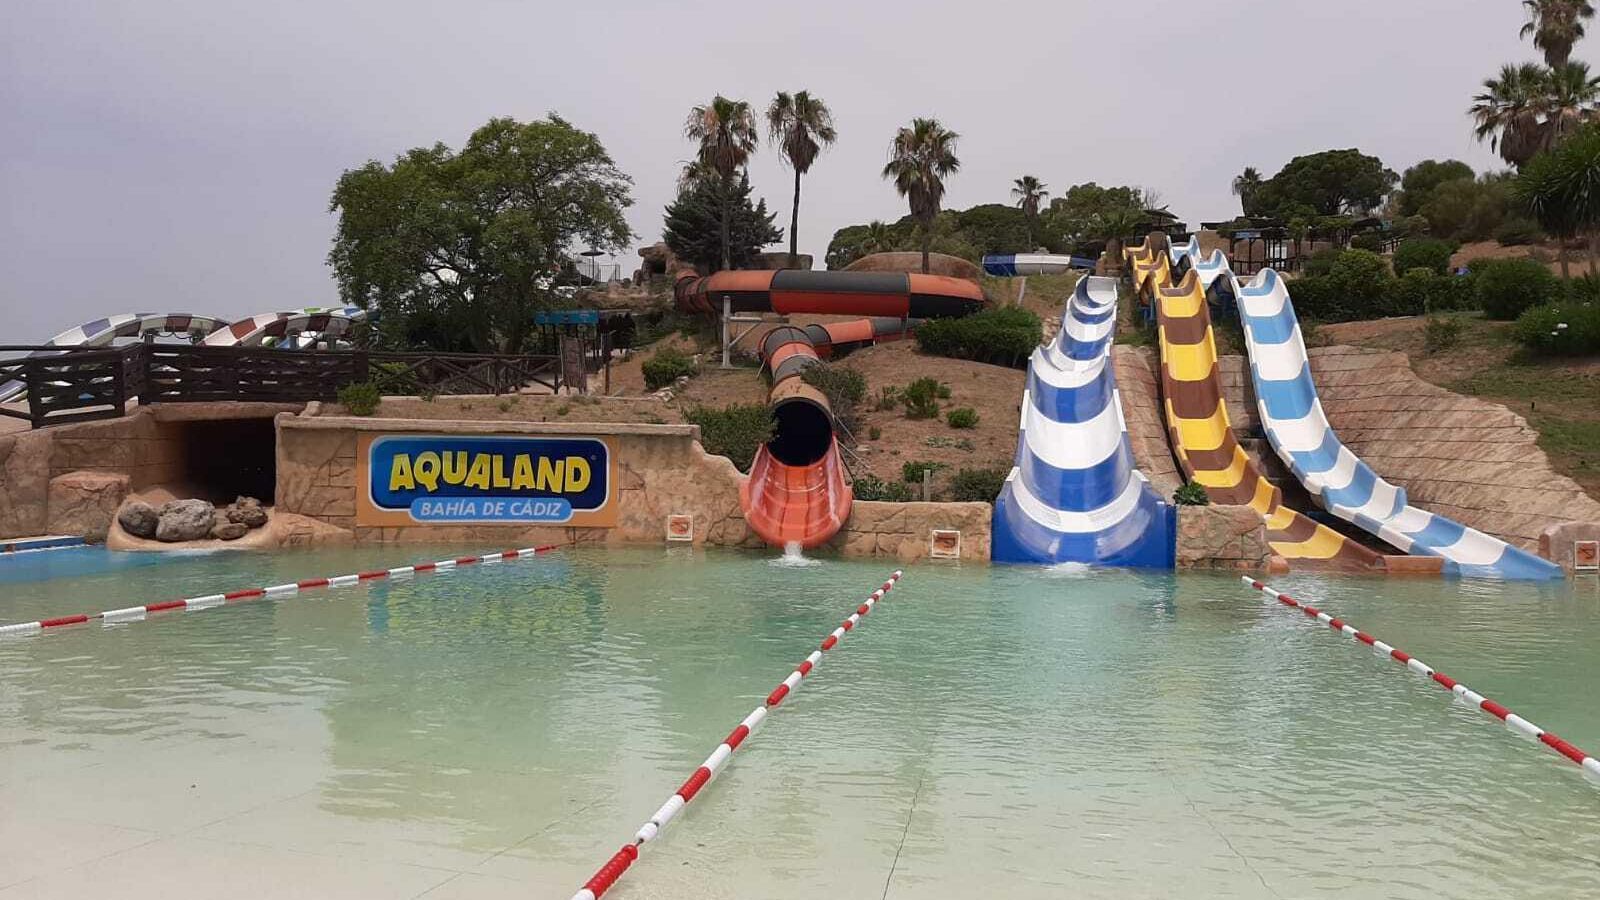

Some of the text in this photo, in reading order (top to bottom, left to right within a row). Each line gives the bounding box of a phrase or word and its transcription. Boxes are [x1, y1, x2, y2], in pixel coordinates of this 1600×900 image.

[389, 451, 591, 493] AQUALAND
[420, 499, 562, 516] BAHÍA DE CÁDIZ
